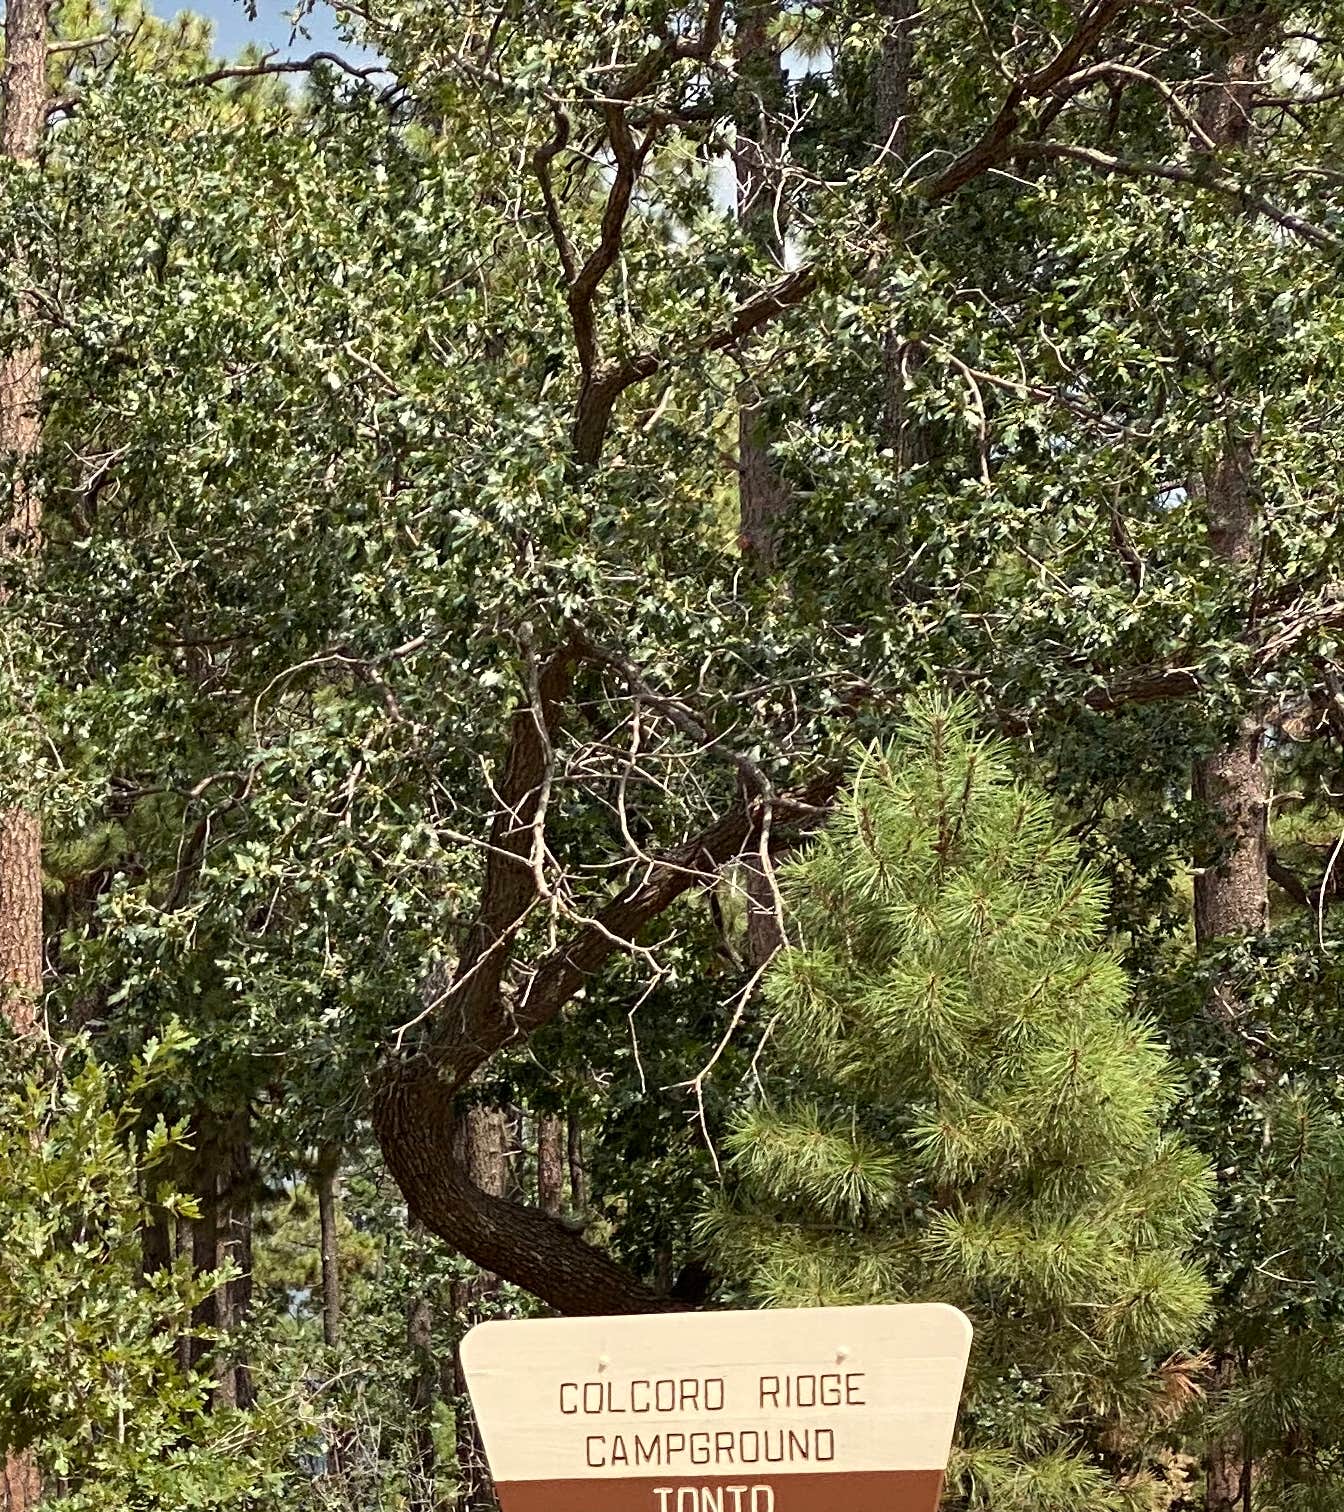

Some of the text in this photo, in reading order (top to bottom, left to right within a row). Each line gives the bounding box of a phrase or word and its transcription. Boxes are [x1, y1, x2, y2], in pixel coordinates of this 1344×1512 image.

[558, 1372, 868, 1415] COLCORD RIDGE
[586, 1428, 836, 1467] CAMPGROUND
